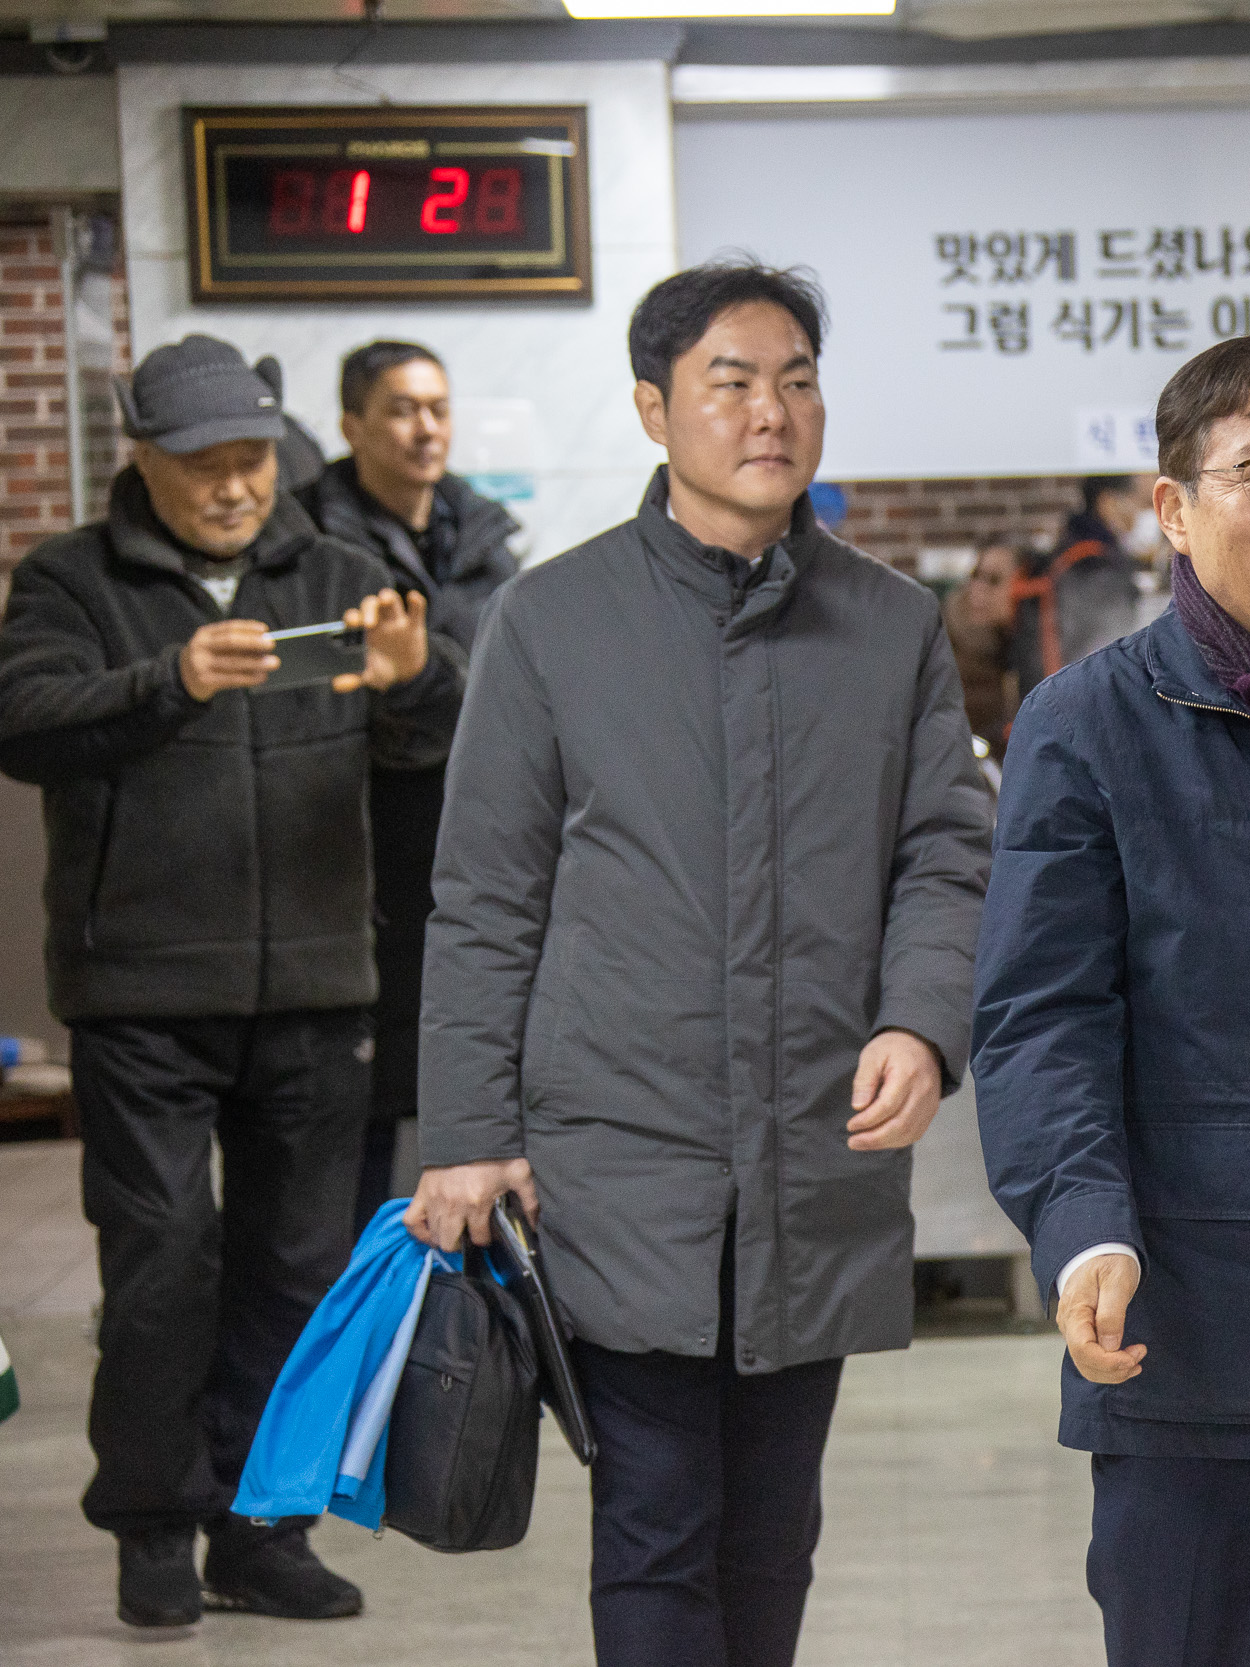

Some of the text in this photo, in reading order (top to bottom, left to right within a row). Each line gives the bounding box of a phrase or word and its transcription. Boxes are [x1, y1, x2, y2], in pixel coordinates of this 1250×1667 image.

[933, 229, 1075, 284] 맛있게
[940, 300, 1030, 354] 그럼
[1051, 298, 1191, 351] 식기는
